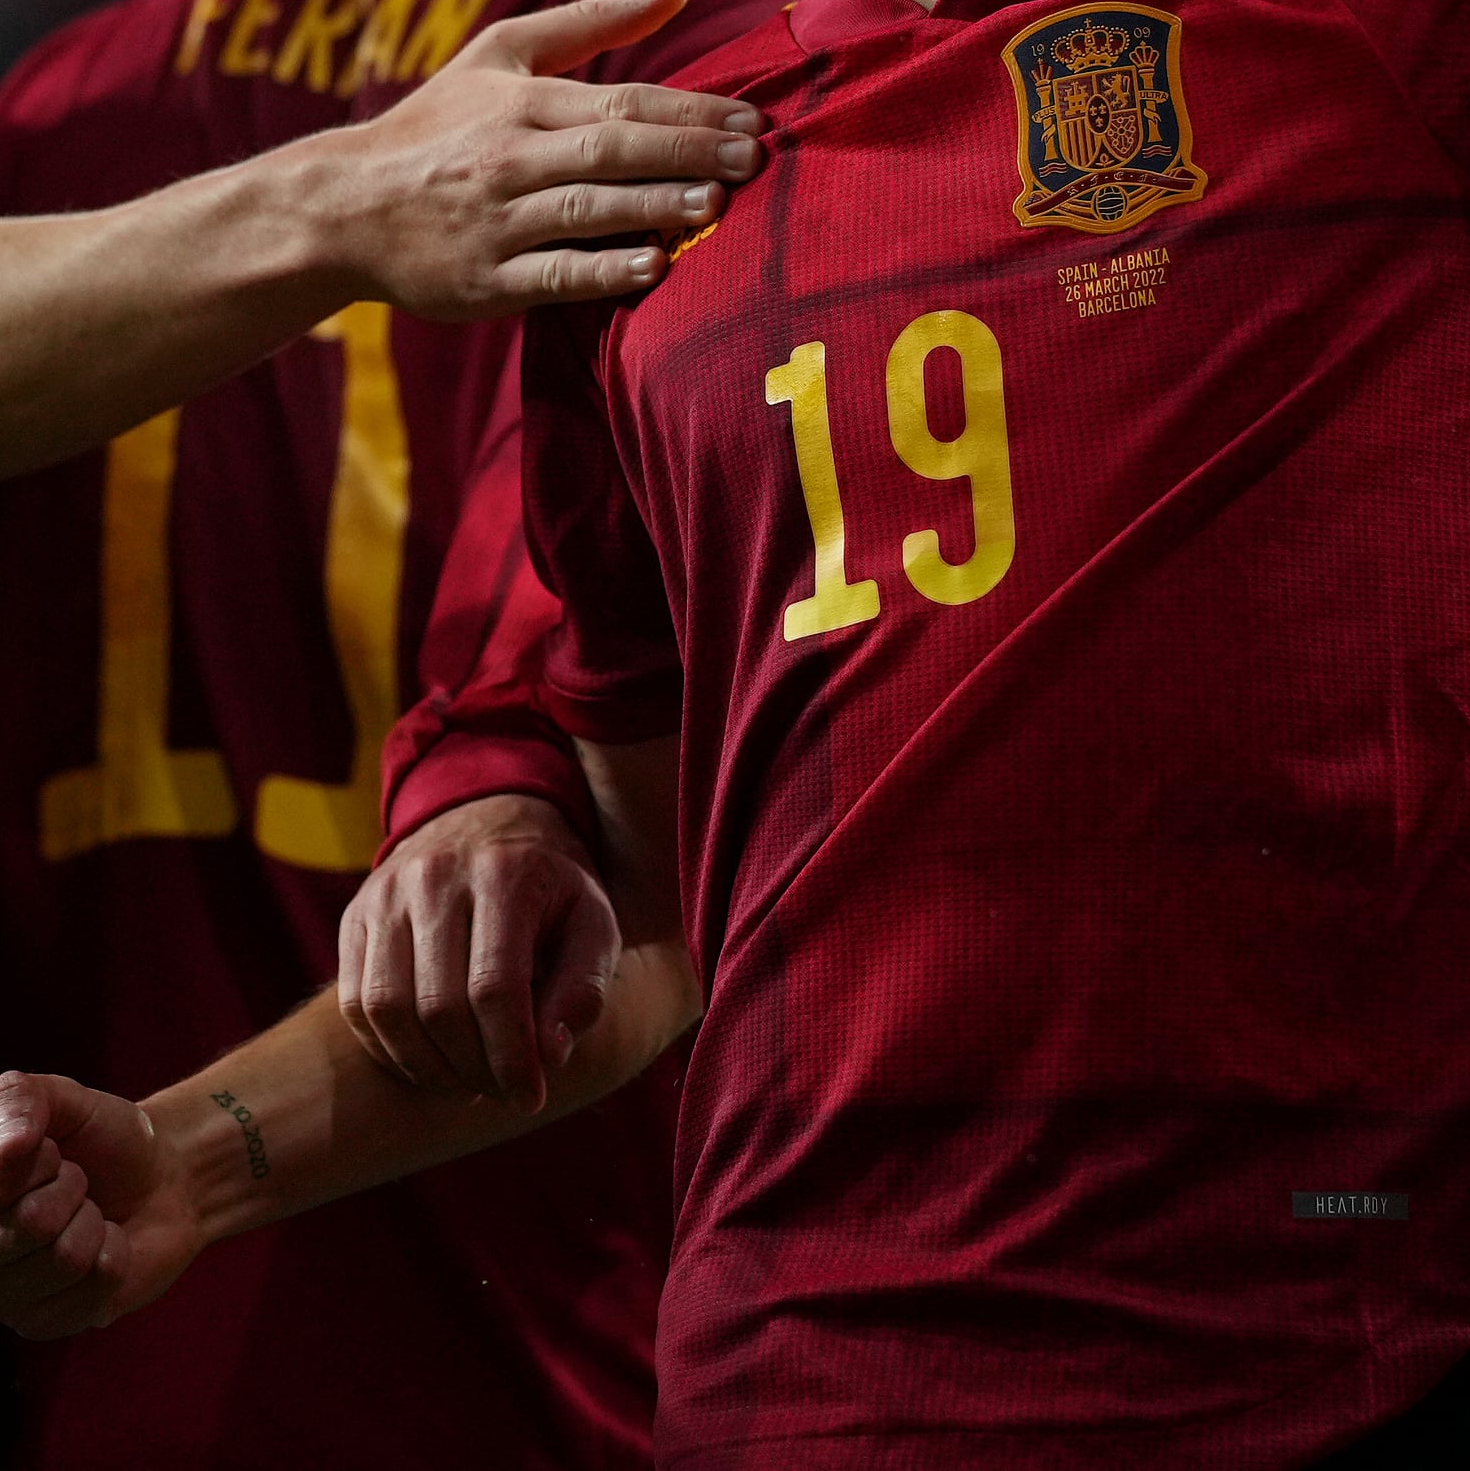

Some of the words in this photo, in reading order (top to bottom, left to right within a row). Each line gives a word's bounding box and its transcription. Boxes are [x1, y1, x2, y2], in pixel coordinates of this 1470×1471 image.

[1133, 27, 1150, 39] 09
[1031, 43, 1045, 57] 19
[1138, 91, 1168, 101] ULTRA
[1033, 107, 1056, 121] PLUS
[1057, 262, 1098, 285] SPAIN
[1111, 247, 1170, 274] ALBANIA
[1065, 285, 1081, 302] 26
[1085, 274, 1129, 298] MARCH
[1133, 268, 1166, 288] 2022
[1078, 288, 1156, 318] BARCELONA
[765, 309, 1016, 642] 19
